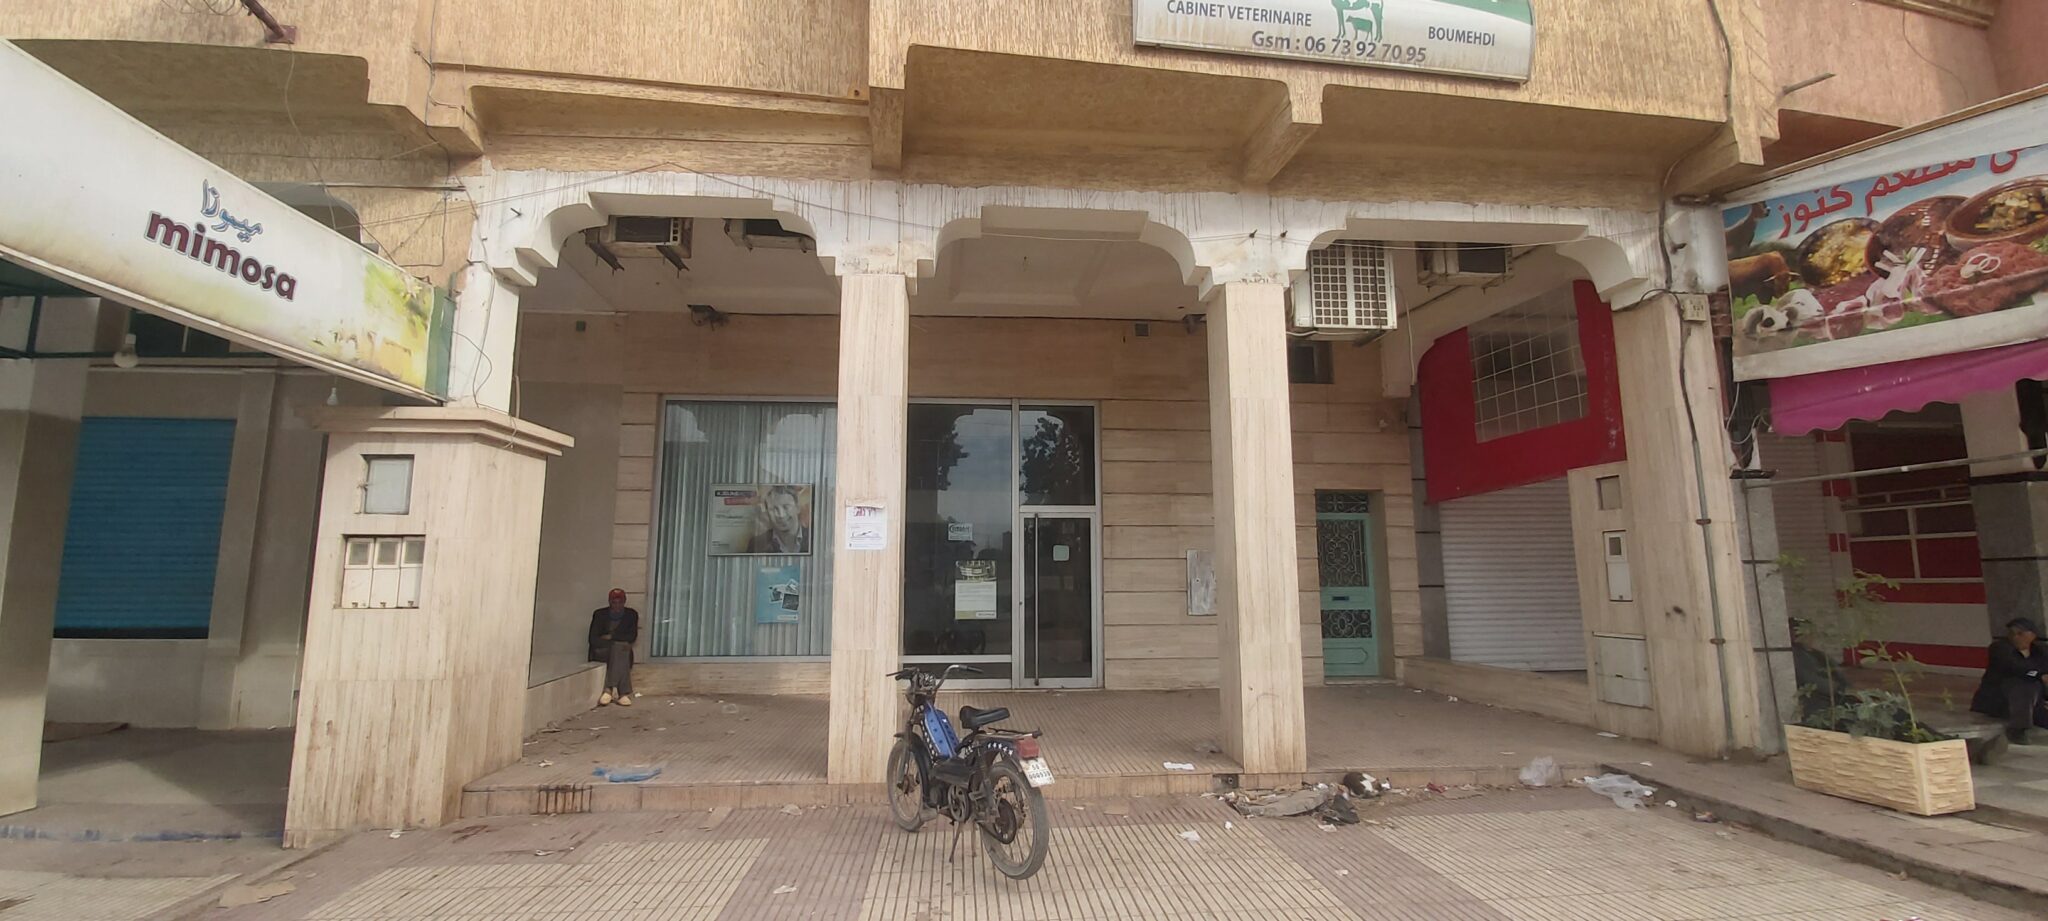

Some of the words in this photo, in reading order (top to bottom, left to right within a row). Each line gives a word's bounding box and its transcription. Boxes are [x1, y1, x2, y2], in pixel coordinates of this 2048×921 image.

[1167, 0, 1225, 18] CABINET
[1228, 5, 1312, 27] VETERINAIRE
[1251, 30, 1291, 50] Gsm
[1304, 36, 1326, 53] 06
[1330, 38, 1352, 56] 73
[1356, 41, 1376, 58] 92
[1381, 43, 1402, 60] 70
[1406, 46, 1427, 62] 95
[1428, 26, 1495, 46] BOUMEHDI
[145, 212, 297, 301] mimosa
